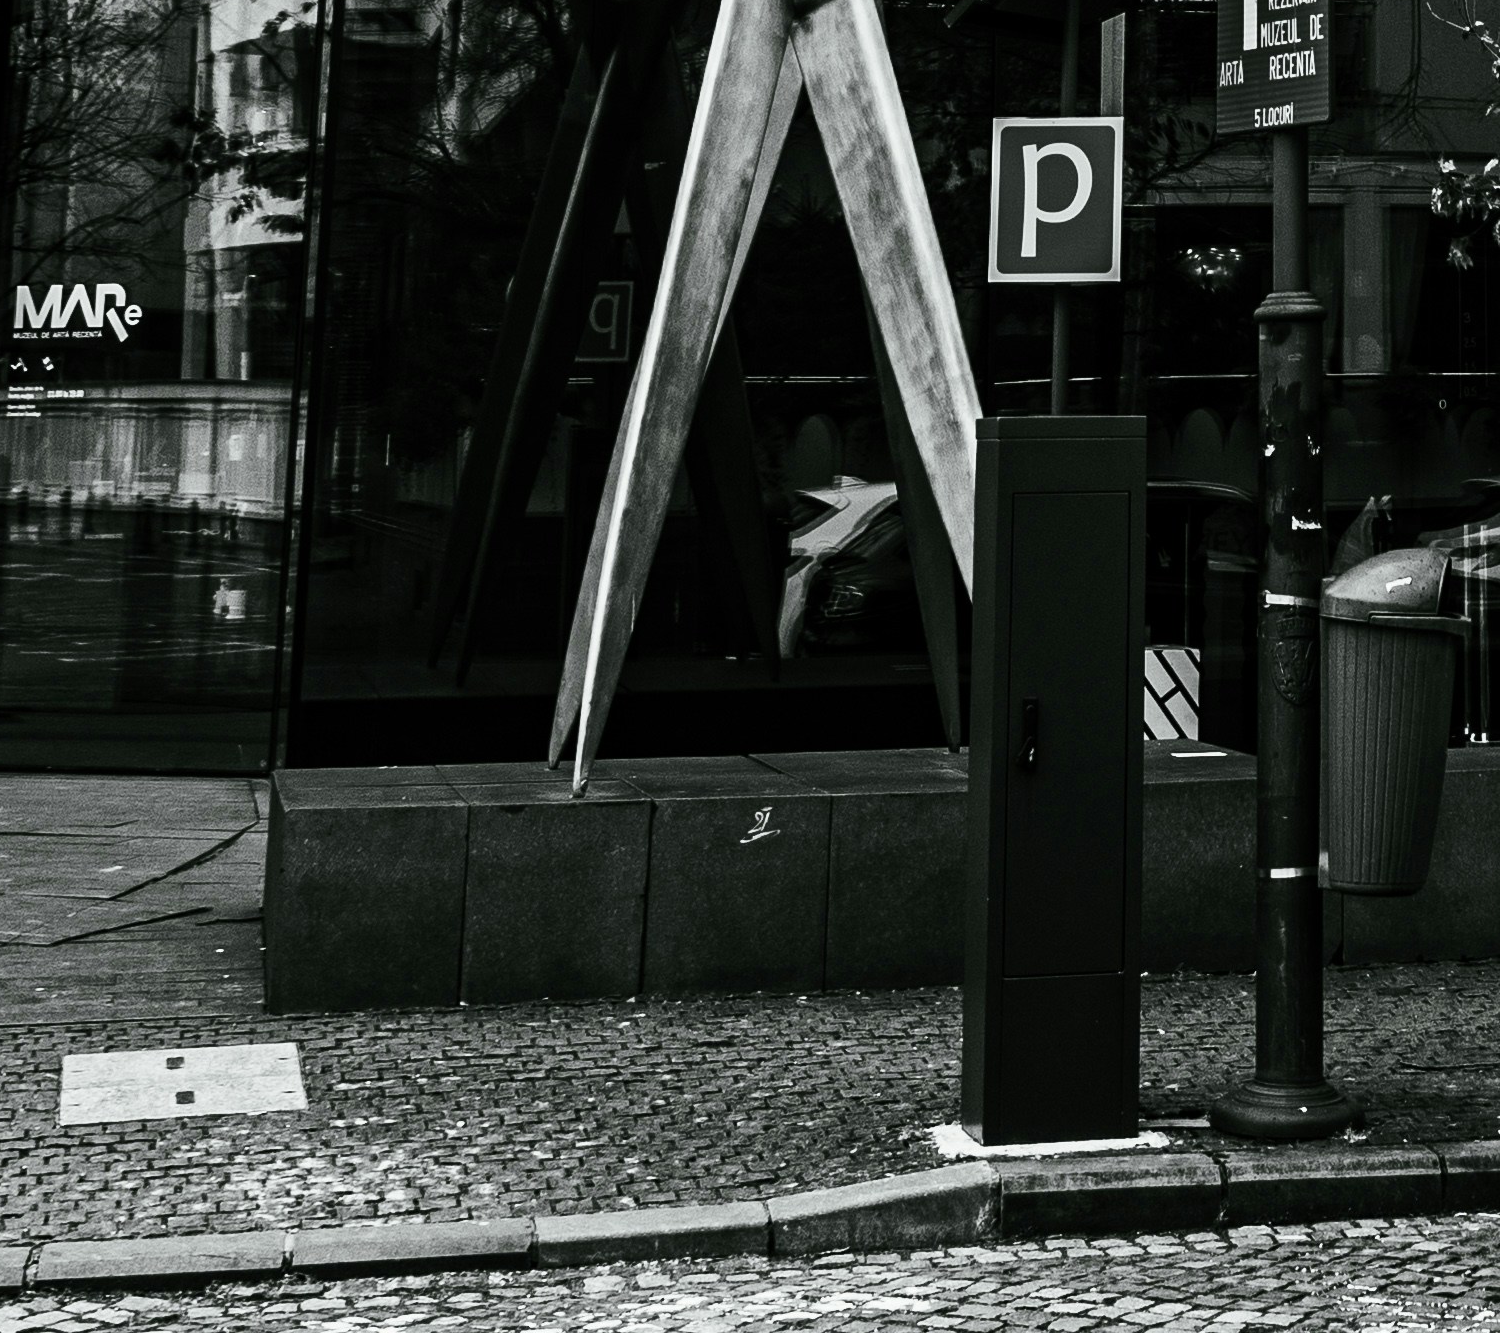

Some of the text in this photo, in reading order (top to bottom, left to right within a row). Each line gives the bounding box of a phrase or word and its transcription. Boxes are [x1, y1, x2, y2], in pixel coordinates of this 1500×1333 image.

[1260, 13, 1325, 48] MUZEUL DE
[1254, 108, 1261, 128] 5
